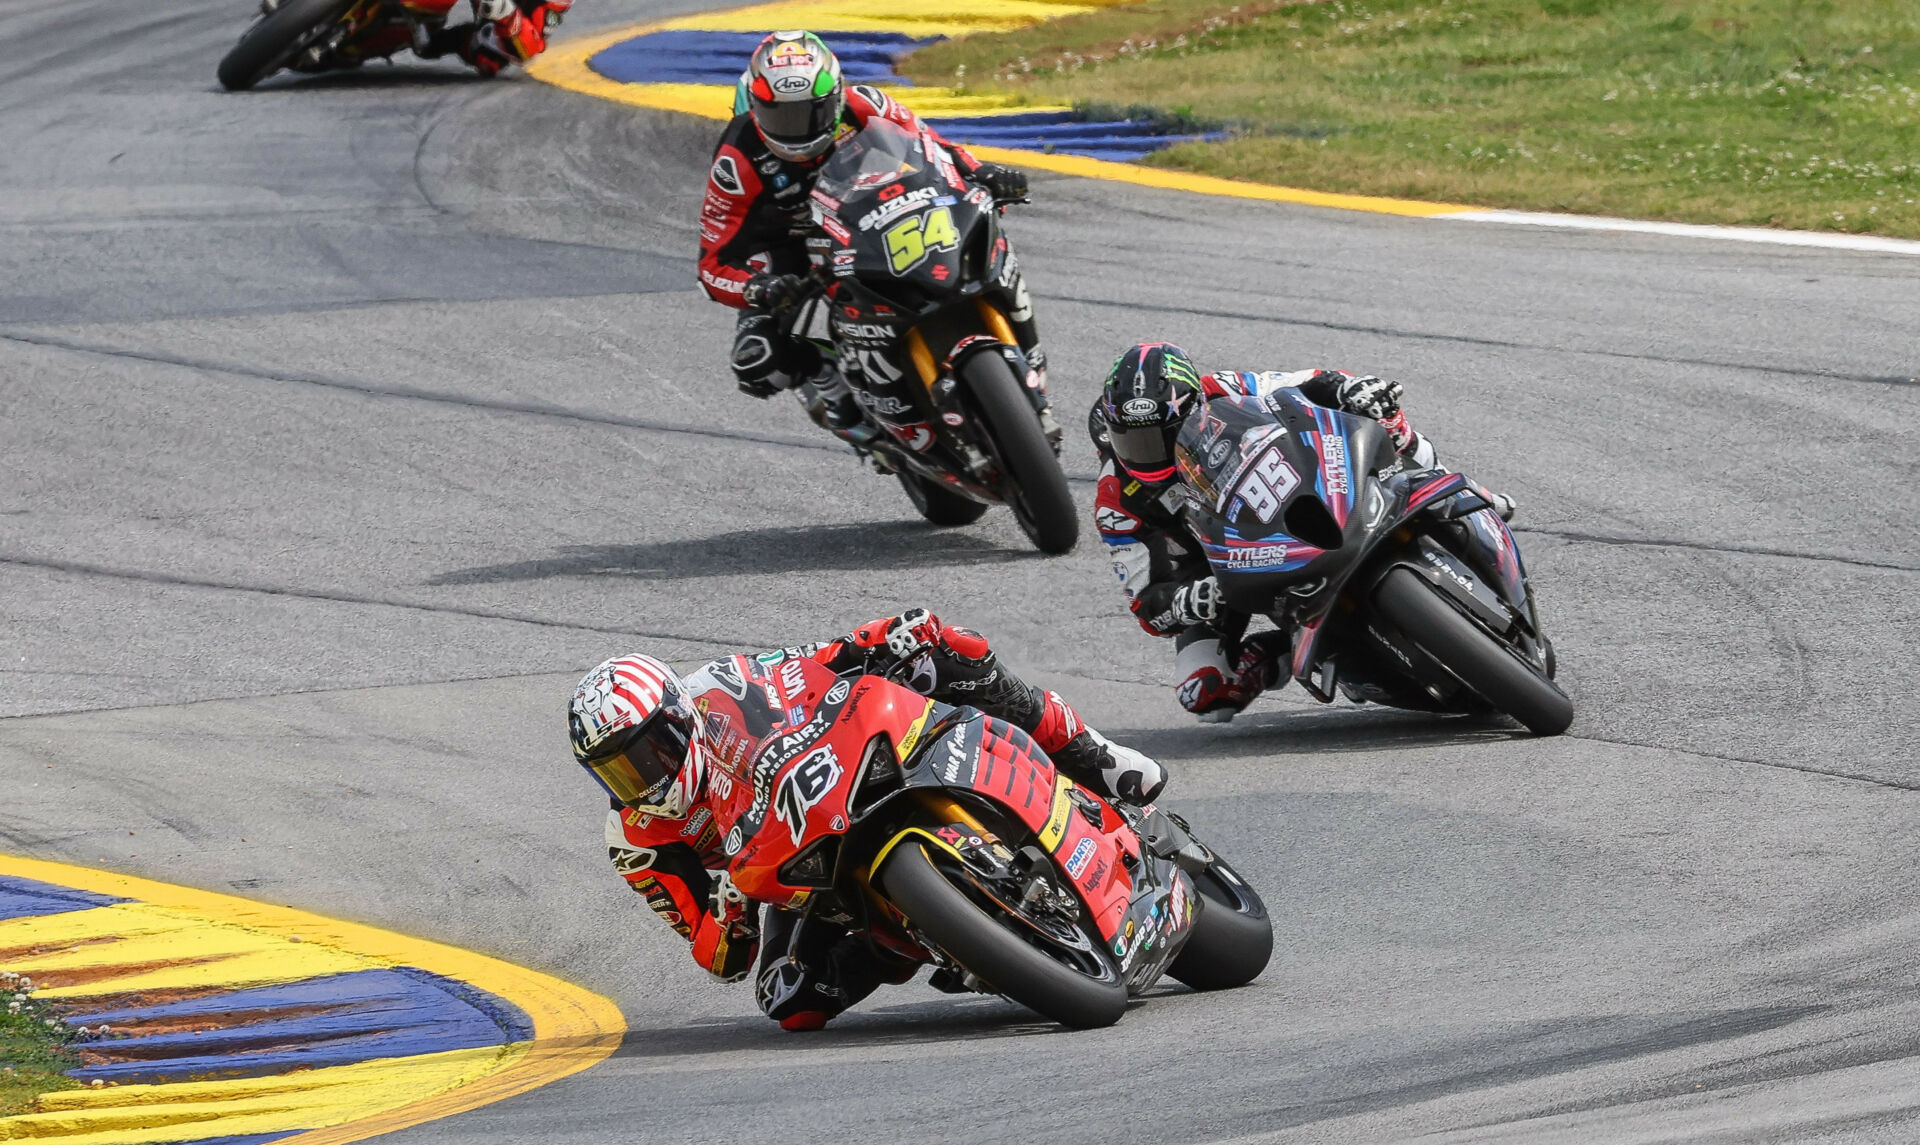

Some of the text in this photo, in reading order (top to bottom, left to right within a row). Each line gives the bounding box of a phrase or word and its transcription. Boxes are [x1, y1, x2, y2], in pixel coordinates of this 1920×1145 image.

[776, 78, 806, 90] Arai
[858, 187, 939, 231] SUZUKI
[882, 206, 960, 277] 54
[702, 270, 747, 294] SUZUK
[1121, 413, 1162, 422] MONSTER
[1322, 434, 1342, 496] TYTLERS
[1335, 435, 1348, 494] CYCLE RACING
[1235, 446, 1302, 524] 95
[1227, 558, 1284, 568] CYCLE RACING
[1228, 544, 1287, 560] TYTLERS
[780, 660, 807, 701] KATO
[747, 744, 776, 820] MOUNT
[781, 711, 825, 752] AIRY
[755, 785, 770, 825] CASINO
[769, 744, 804, 776] RESORT
[813, 721, 832, 740] SPA
[944, 754, 961, 783] WAR
[638, 774, 670, 798] DELCOURT
[774, 743, 844, 848] 76
[681, 806, 705, 836] bonovo
[691, 810, 711, 836] action
[1066, 837, 1092, 873] PARTS
[1072, 842, 1097, 880] UNLIMITED
[1120, 925, 1146, 973] DUNLOP
